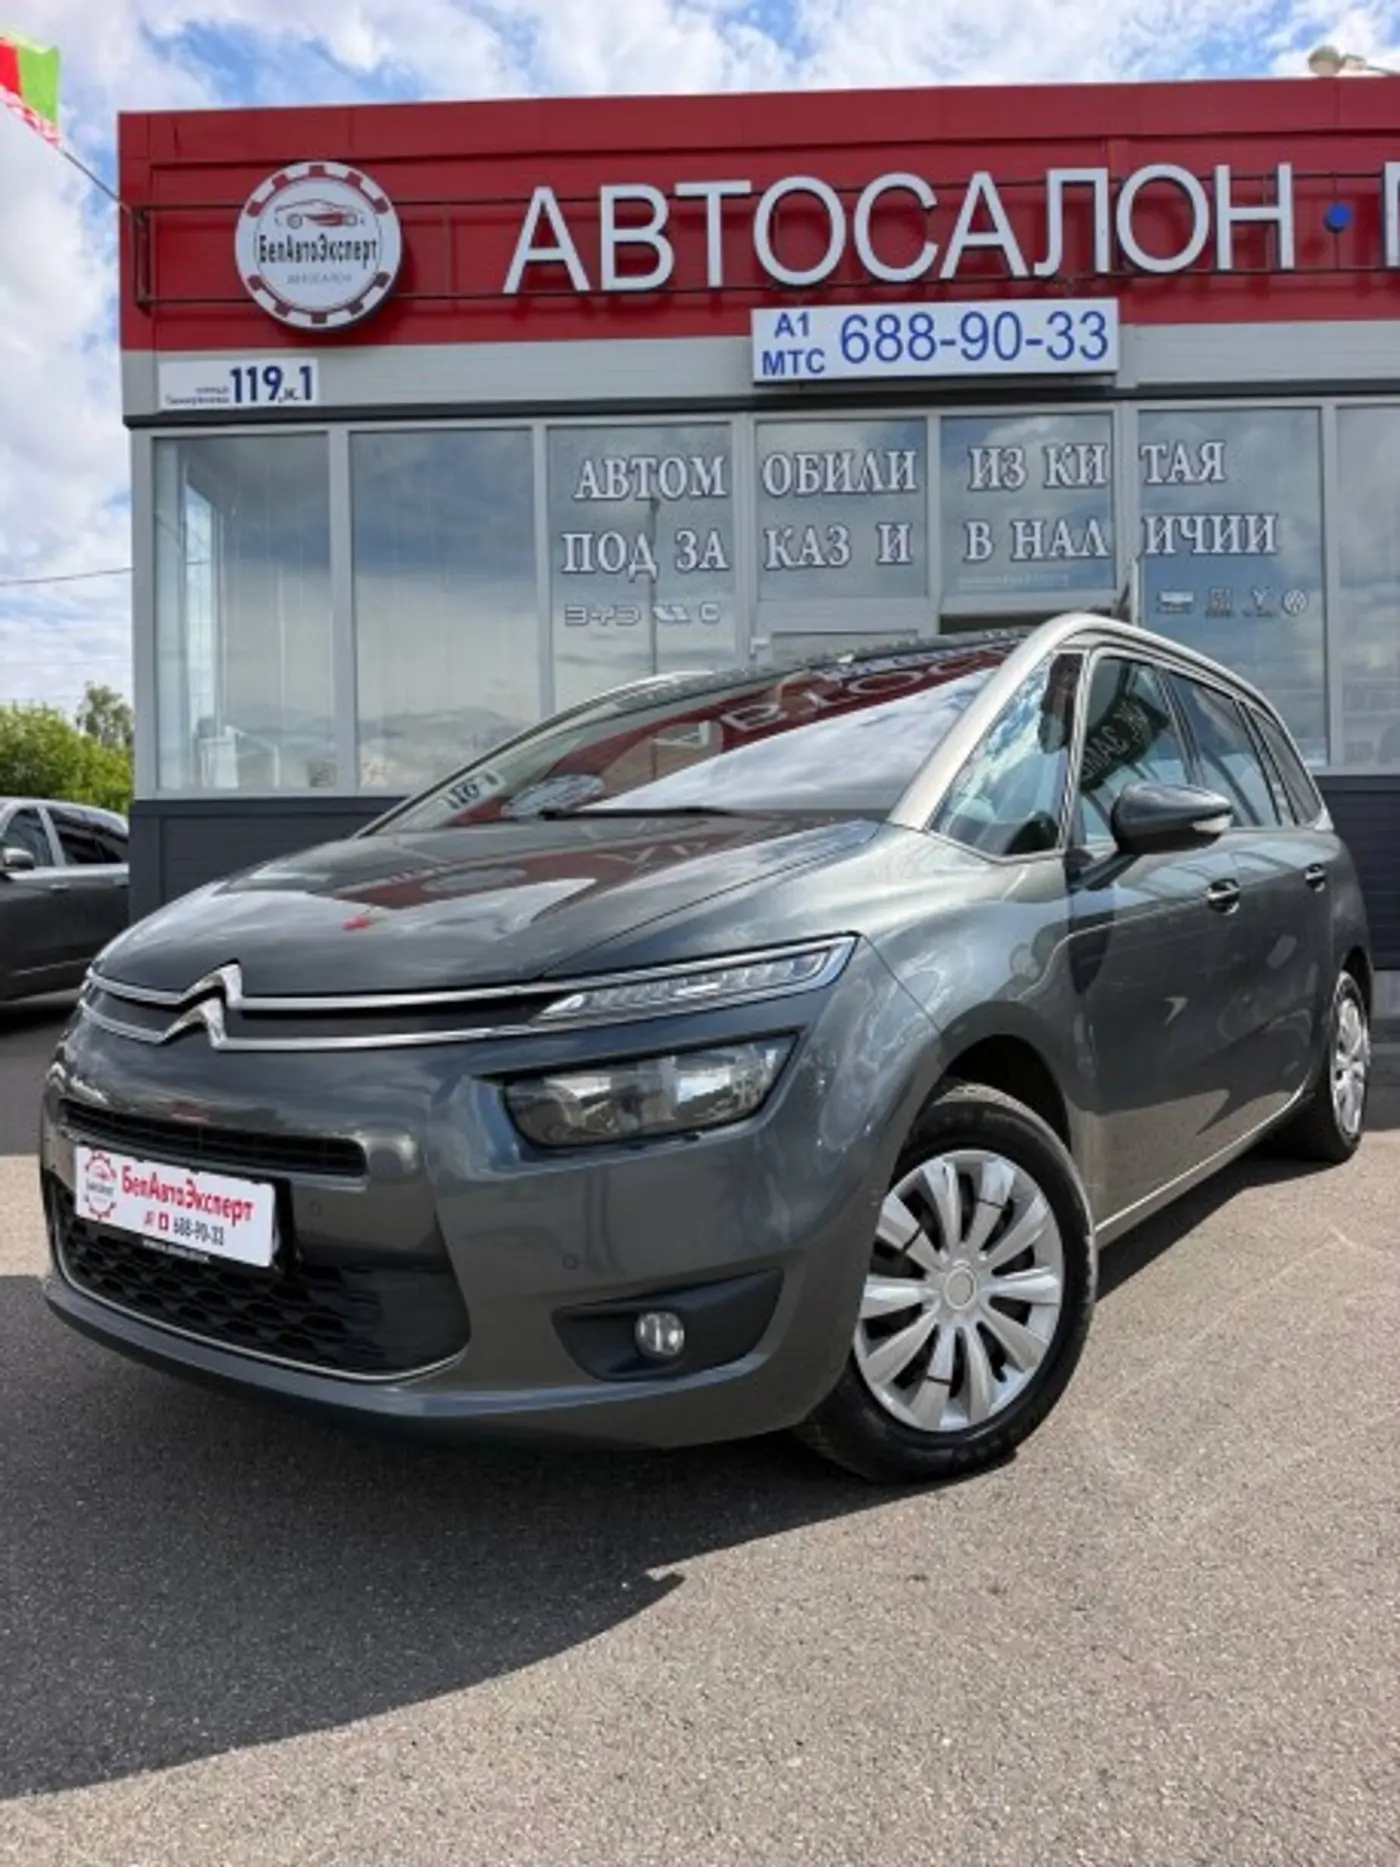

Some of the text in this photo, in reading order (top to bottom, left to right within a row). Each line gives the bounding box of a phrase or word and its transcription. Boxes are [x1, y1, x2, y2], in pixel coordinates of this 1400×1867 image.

[503, 162, 1295, 295] АВТОСАЛОН
[761, 348, 826, 376] МТС
[840, 309, 1109, 364] 688-90-33
[967, 446, 1027, 490] ИЗ
[560, 530, 660, 584] ПОД
[875, 522, 915, 566] И
[964, 520, 995, 562] В
